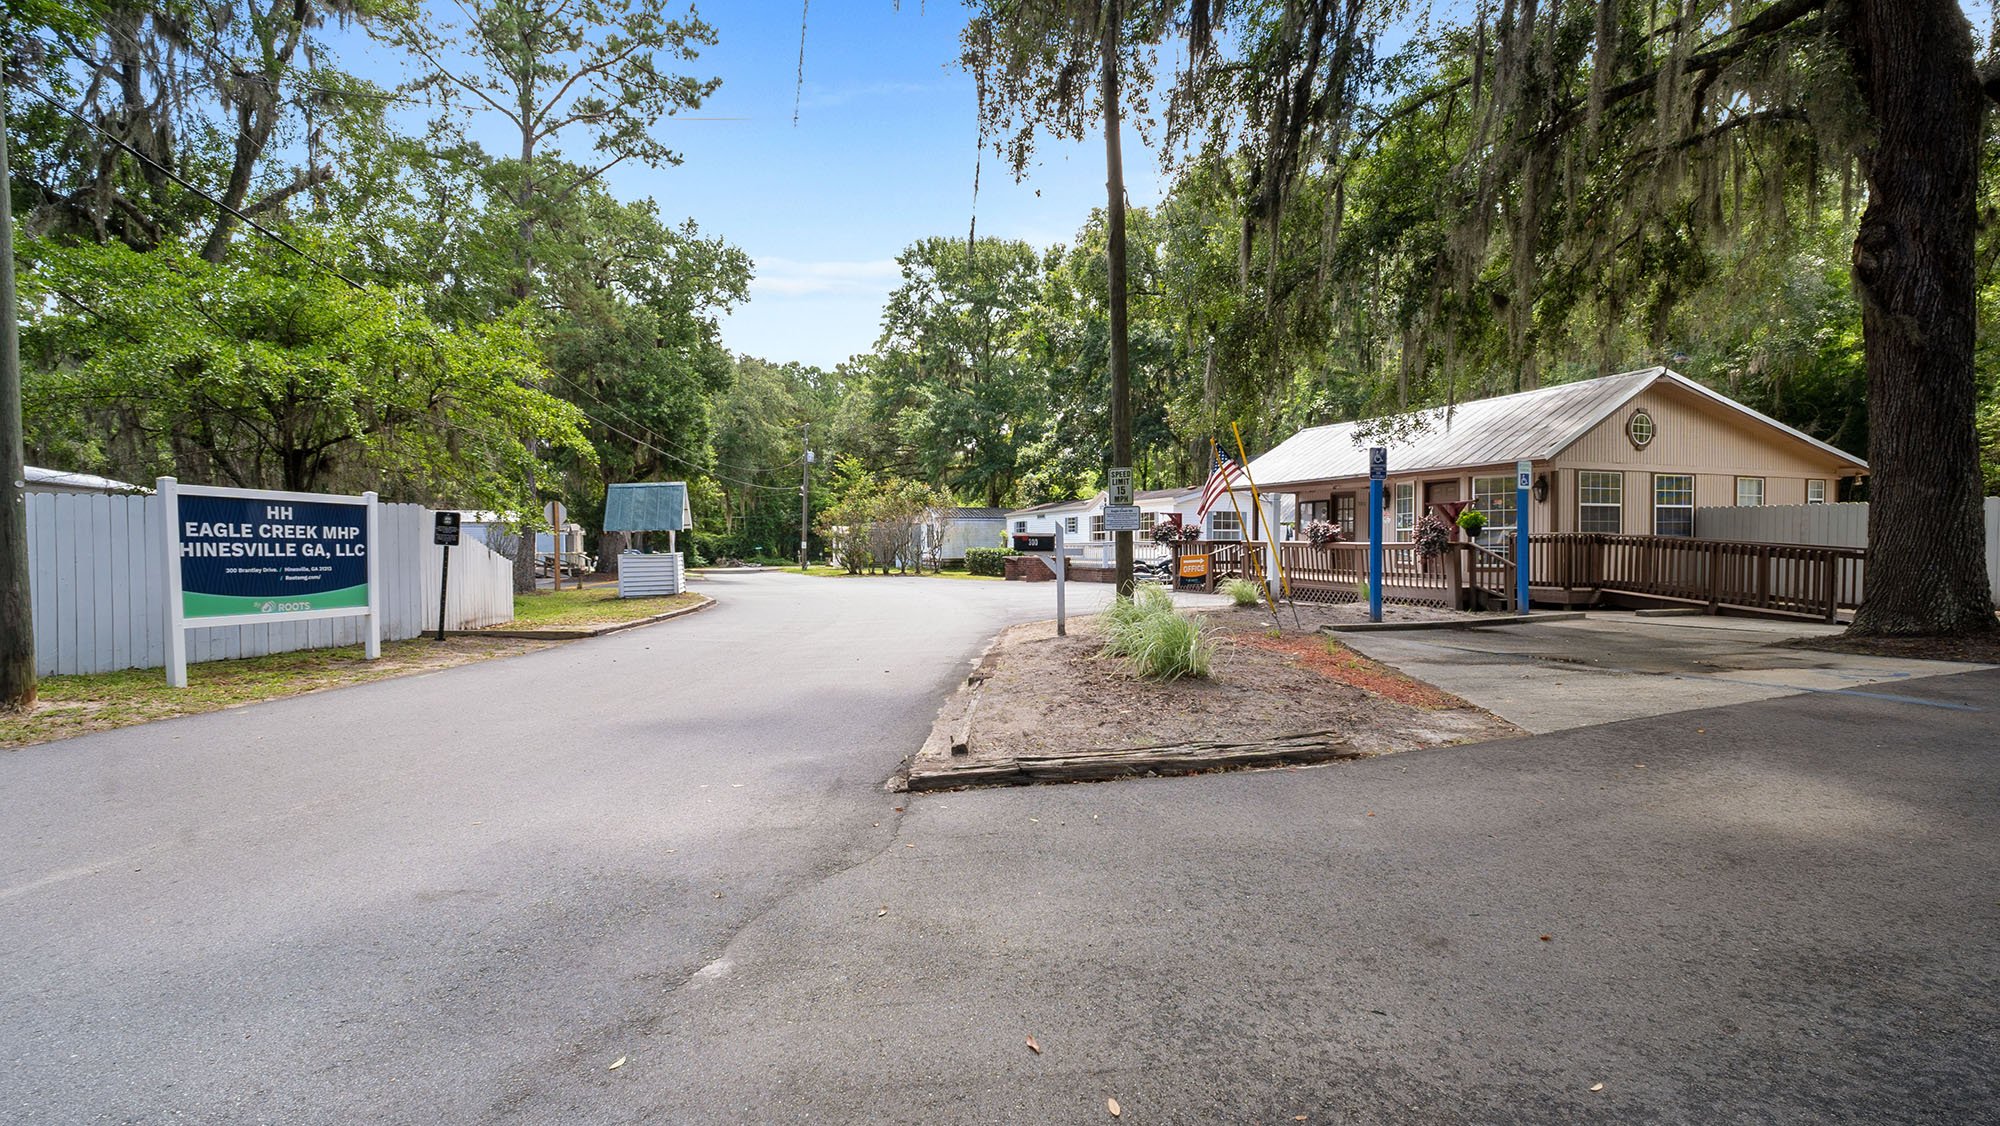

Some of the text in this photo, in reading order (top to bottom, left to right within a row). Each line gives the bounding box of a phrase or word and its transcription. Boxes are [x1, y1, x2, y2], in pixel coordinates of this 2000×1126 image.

[1116, 486, 1126, 495] 15
[266, 505, 293, 520] HH
[185, 522, 360, 540] EAGLE CREEK MHP
[180, 542, 365, 559] HINESVILLE GA, LLC
[1183, 565, 1205, 573] OFFICE
[278, 601, 311, 612] ROOTS
